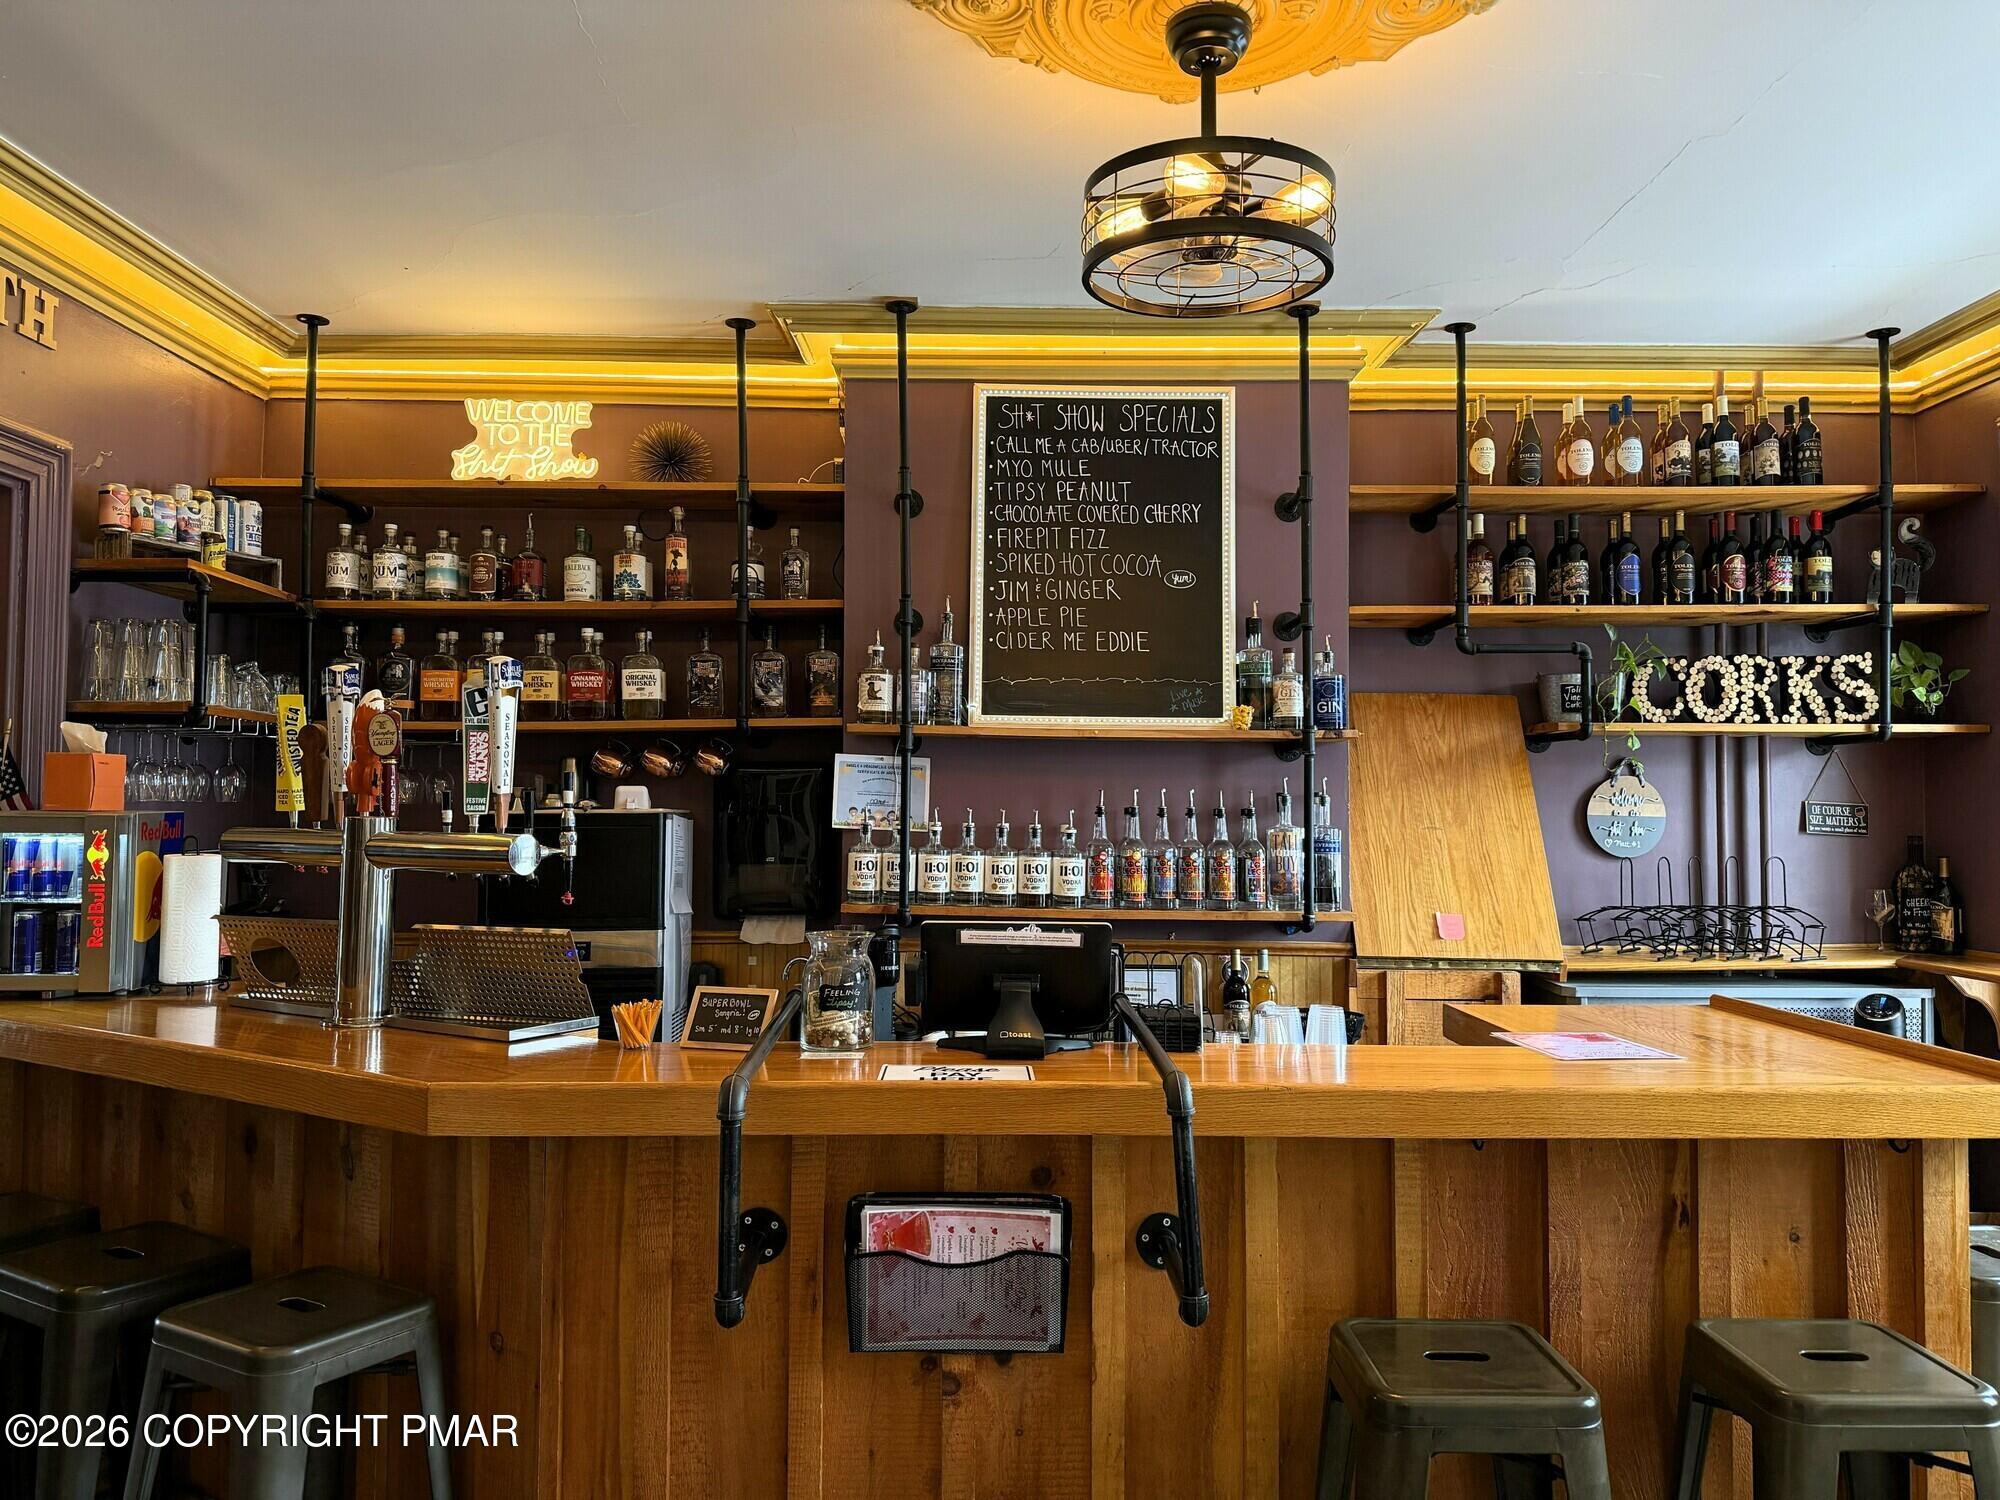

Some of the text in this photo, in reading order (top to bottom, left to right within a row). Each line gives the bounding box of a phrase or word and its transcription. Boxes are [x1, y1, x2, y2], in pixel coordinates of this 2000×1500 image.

[466, 399, 590, 425] WELCOME
[1053, 403, 1104, 432] SHOW
[1119, 403, 1216, 433] SPECIALS
[483, 423, 571, 447] TO THE
[995, 435, 1032, 454] CALL
[1035, 437, 1054, 454] ME
[1056, 438, 1067, 453] A
[1041, 459, 1092, 477] MULE
[994, 481, 1132, 503] TIPSY PEANUT
[994, 503, 1202, 525] CHOCOLATE COVERED CHERRY
[997, 527, 1110, 550] FIREPIT FIZZ
[995, 552, 1162, 578] SPIKED HOT COCOA
[327, 565, 349, 578] RUM
[373, 565, 397, 578] RUM
[995, 579, 1029, 602] JIM
[1045, 579, 1121, 601] GINGER
[995, 606, 1089, 628] APPLE PIE
[995, 631, 1150, 652] CIDER ME EDDIE
[1280, 689, 1300, 698] GIN
[1632, 652, 1879, 724] CORKS
[1317, 701, 1341, 713] GIN
[285, 706, 300, 726] TEA
[373, 739, 395, 747] LAGER
[477, 731, 489, 782] SANTA!
[1812, 805, 1852, 816] OF COURSE
[1809, 815, 1858, 826] SIZE MATTERS
[855, 860, 878, 871] 11:01
[925, 862, 948, 873] 11:01
[955, 861, 979, 873] 11:01
[992, 863, 1015, 875] 11:01
[1023, 863, 1047, 875] 11:01
[1060, 865, 1083, 877] 11:01
[994, 876, 1013, 884] VODKA
[1026, 876, 1045, 884] VODKA
[1906, 898, 1931, 907] CHEER
[824, 988, 860, 998] FEELING
[702, 997, 752, 1008] SUPER BOWL
[1009, 1031, 1032, 1039] toast
